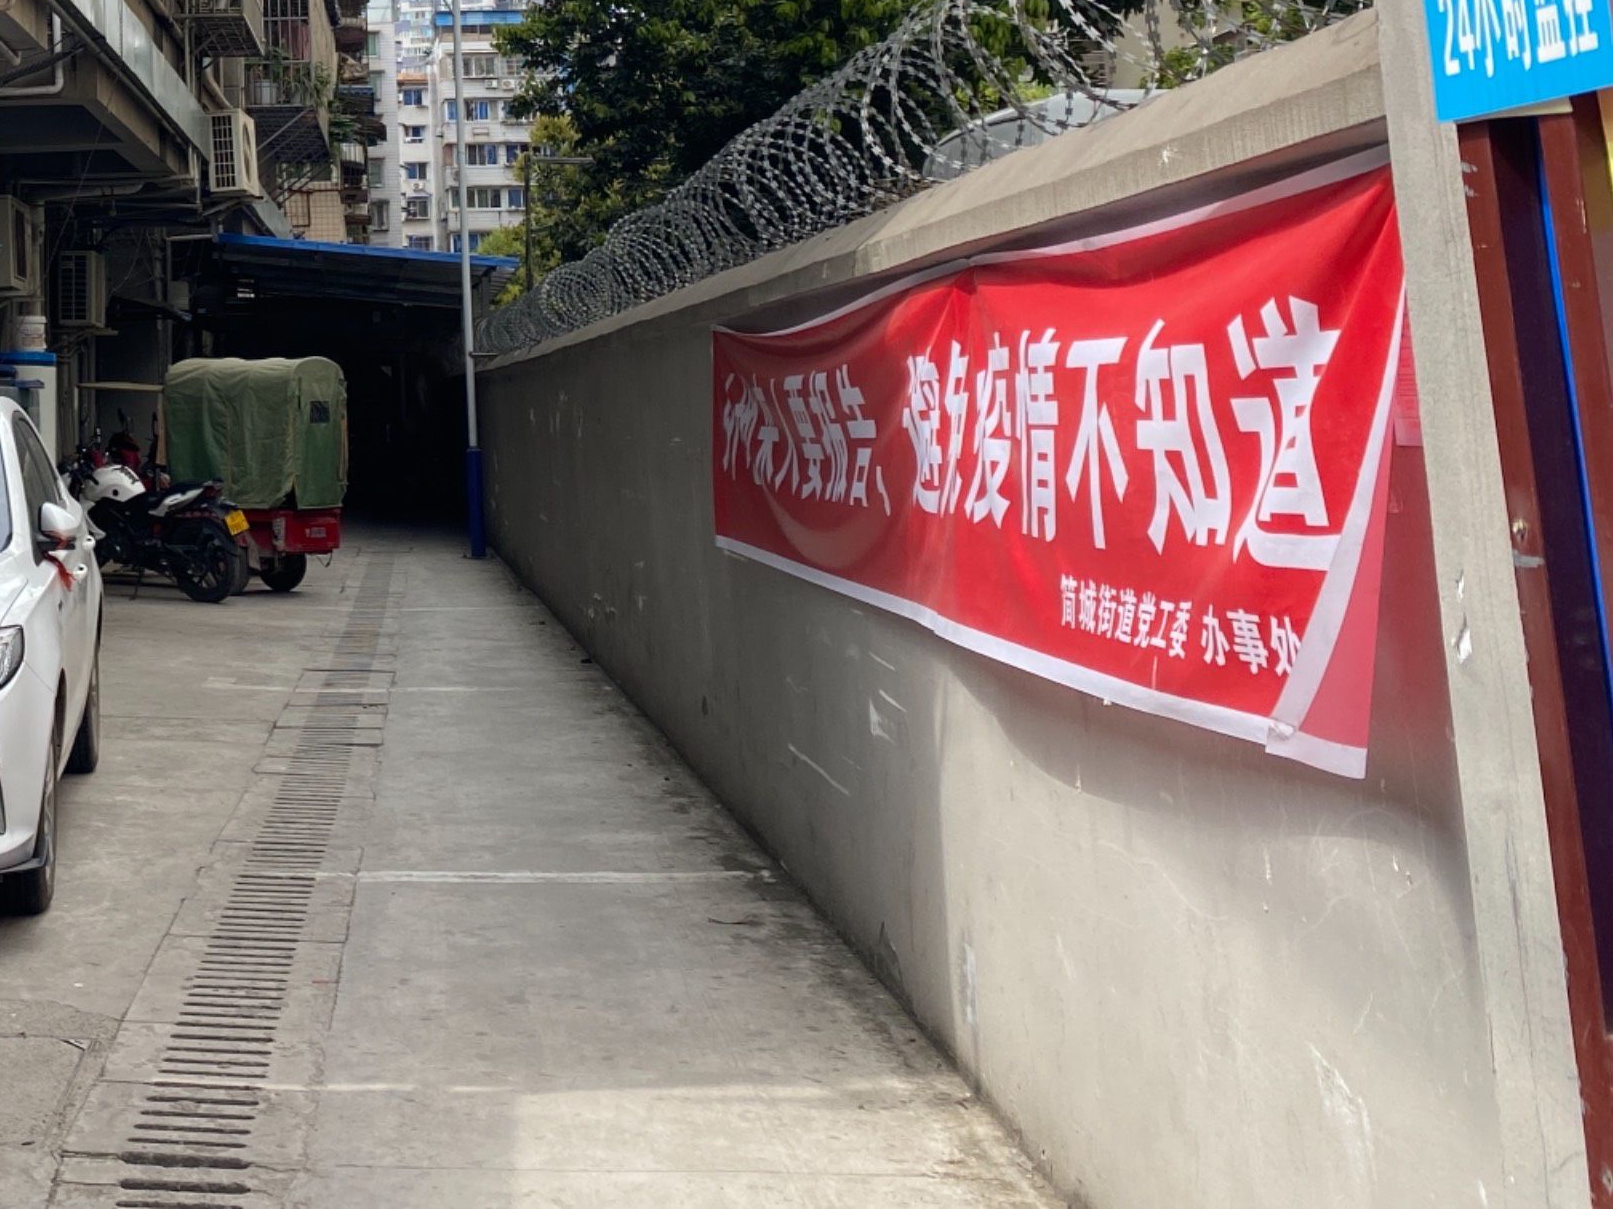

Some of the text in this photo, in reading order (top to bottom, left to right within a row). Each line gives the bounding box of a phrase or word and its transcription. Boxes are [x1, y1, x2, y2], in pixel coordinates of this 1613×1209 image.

[1060, 574, 1302, 677] 简城街道党工委 办事处
